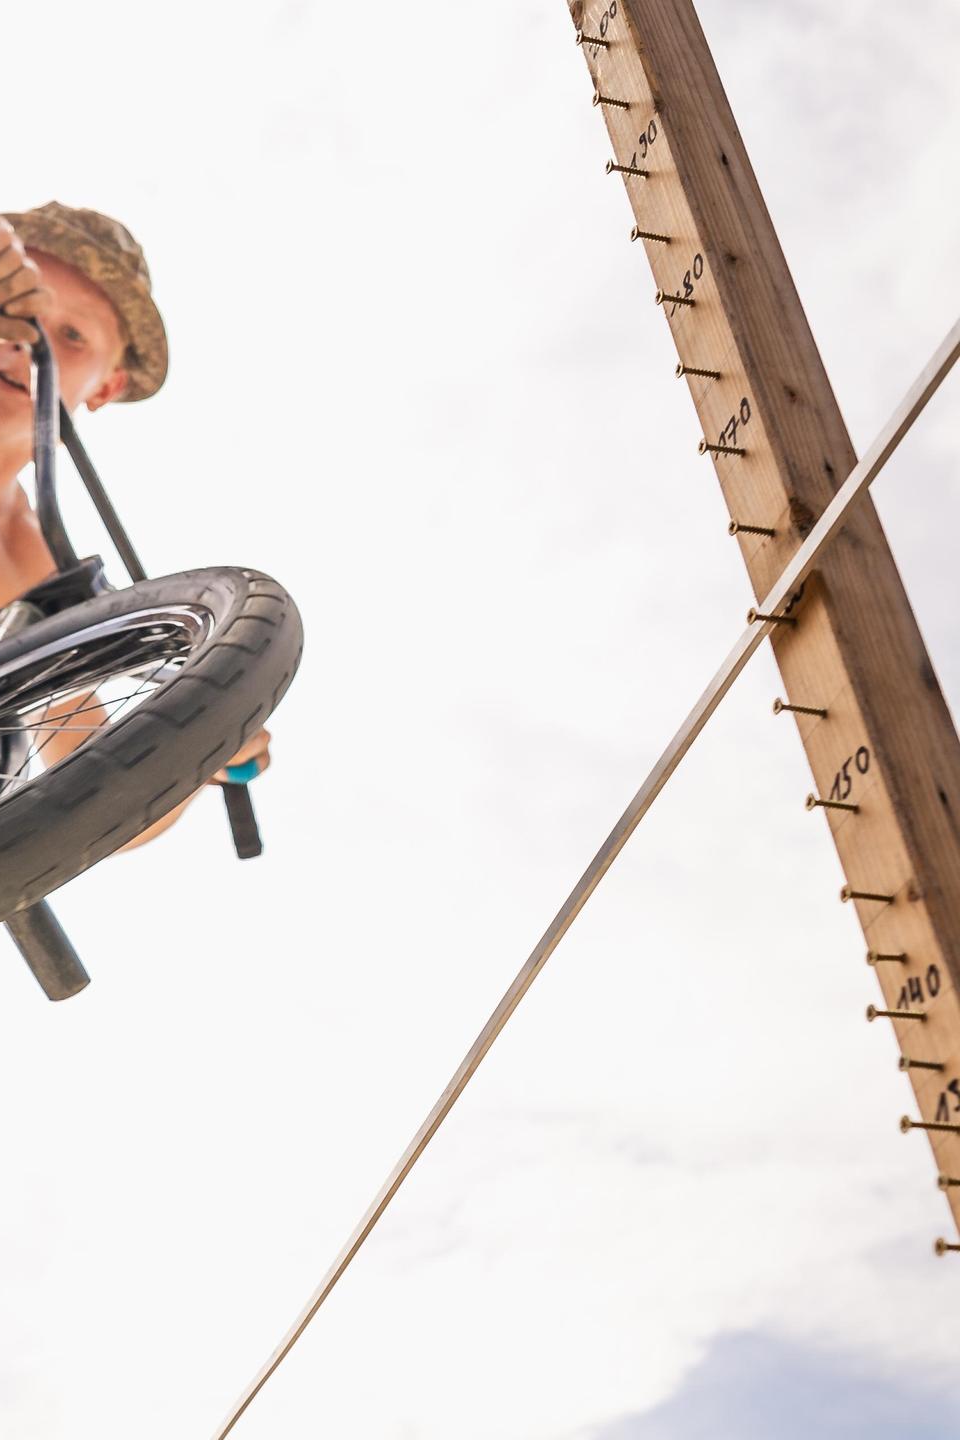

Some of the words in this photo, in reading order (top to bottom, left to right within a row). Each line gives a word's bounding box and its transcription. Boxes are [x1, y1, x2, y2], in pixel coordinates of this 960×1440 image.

[588, 1, 617, 59] 00
[829, 746, 870, 800] 150
[897, 964, 940, 1010] 140
